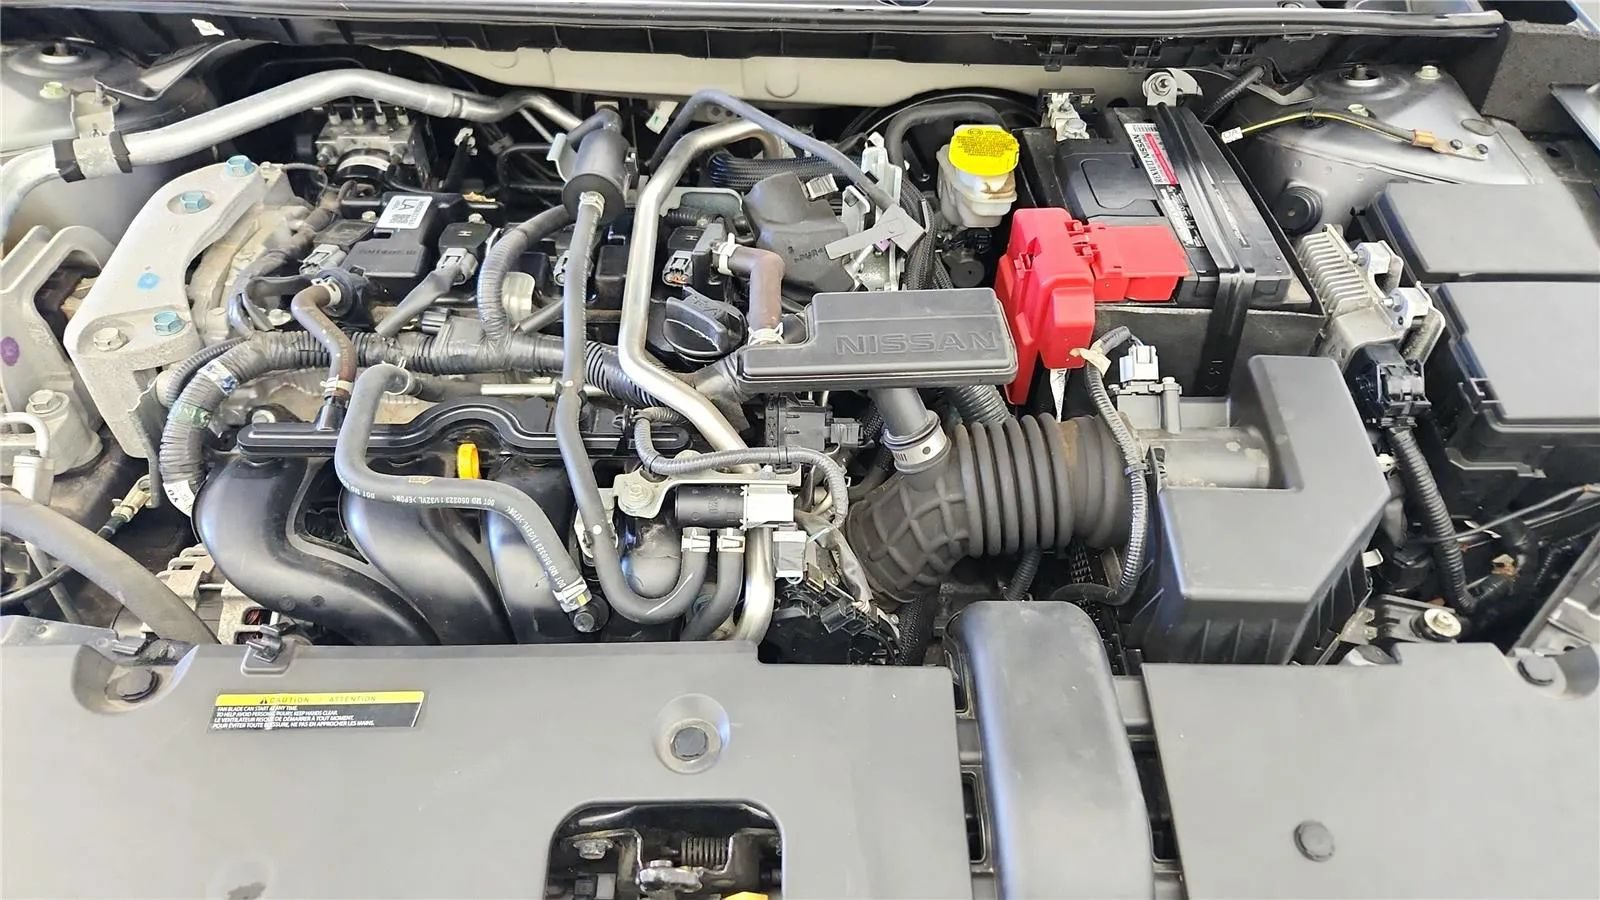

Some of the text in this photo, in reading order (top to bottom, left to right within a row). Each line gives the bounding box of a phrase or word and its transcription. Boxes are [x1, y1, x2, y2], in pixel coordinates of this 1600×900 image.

[1132, 133, 1150, 159] NISSAN
[834, 331, 999, 355] NISSAN
[328, 695, 376, 703] ATTENTION
